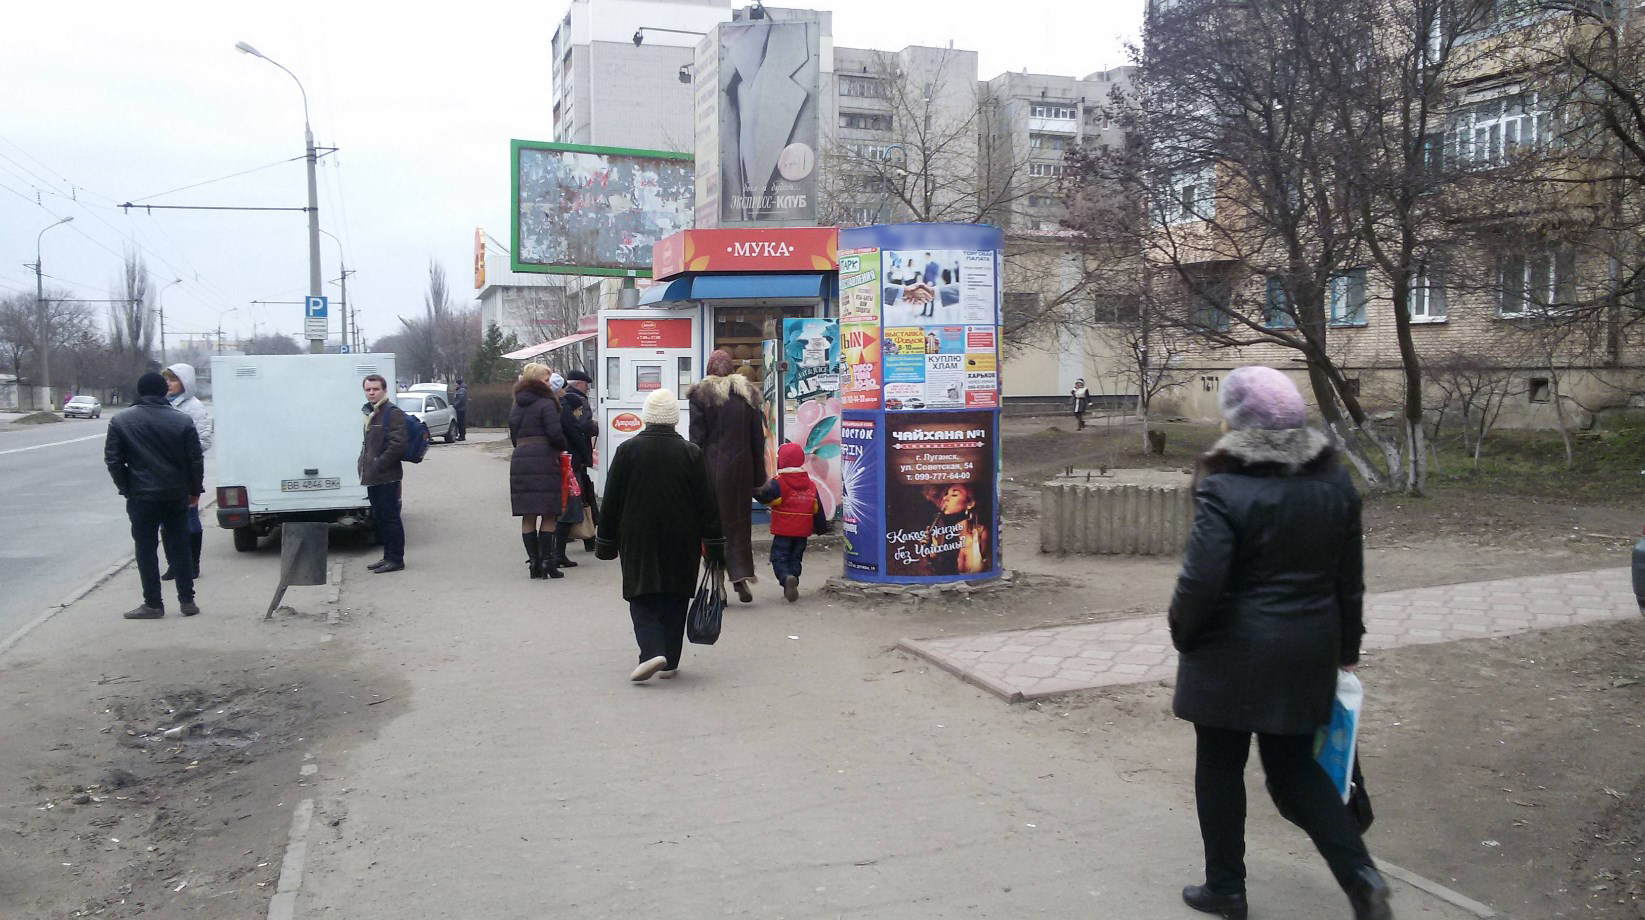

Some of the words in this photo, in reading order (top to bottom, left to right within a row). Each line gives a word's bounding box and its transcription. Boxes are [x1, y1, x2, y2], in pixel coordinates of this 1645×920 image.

[731, 194, 807, 209] ЭКСПРЕСС-КЛУБ
[733, 241, 790, 257] МУКА
[310, 297, 323, 316] P
[928, 355, 962, 363] КУПЛЮ
[932, 362, 958, 370] ХЛАМ
[892, 429, 964, 440] ЧАЙХАНА
[966, 430, 986, 439] №1
[923, 453, 960, 462] Луганск,
[900, 464, 914, 473] ул.
[915, 463, 963, 471] Советская,
[963, 461, 974, 469] 54
[914, 471, 971, 481] 099-777-64-00
[886, 528, 927, 543] Какая
[931, 523, 964, 540] жизнь
[894, 546, 920, 565] без
[914, 535, 967, 557] Чайханы?
